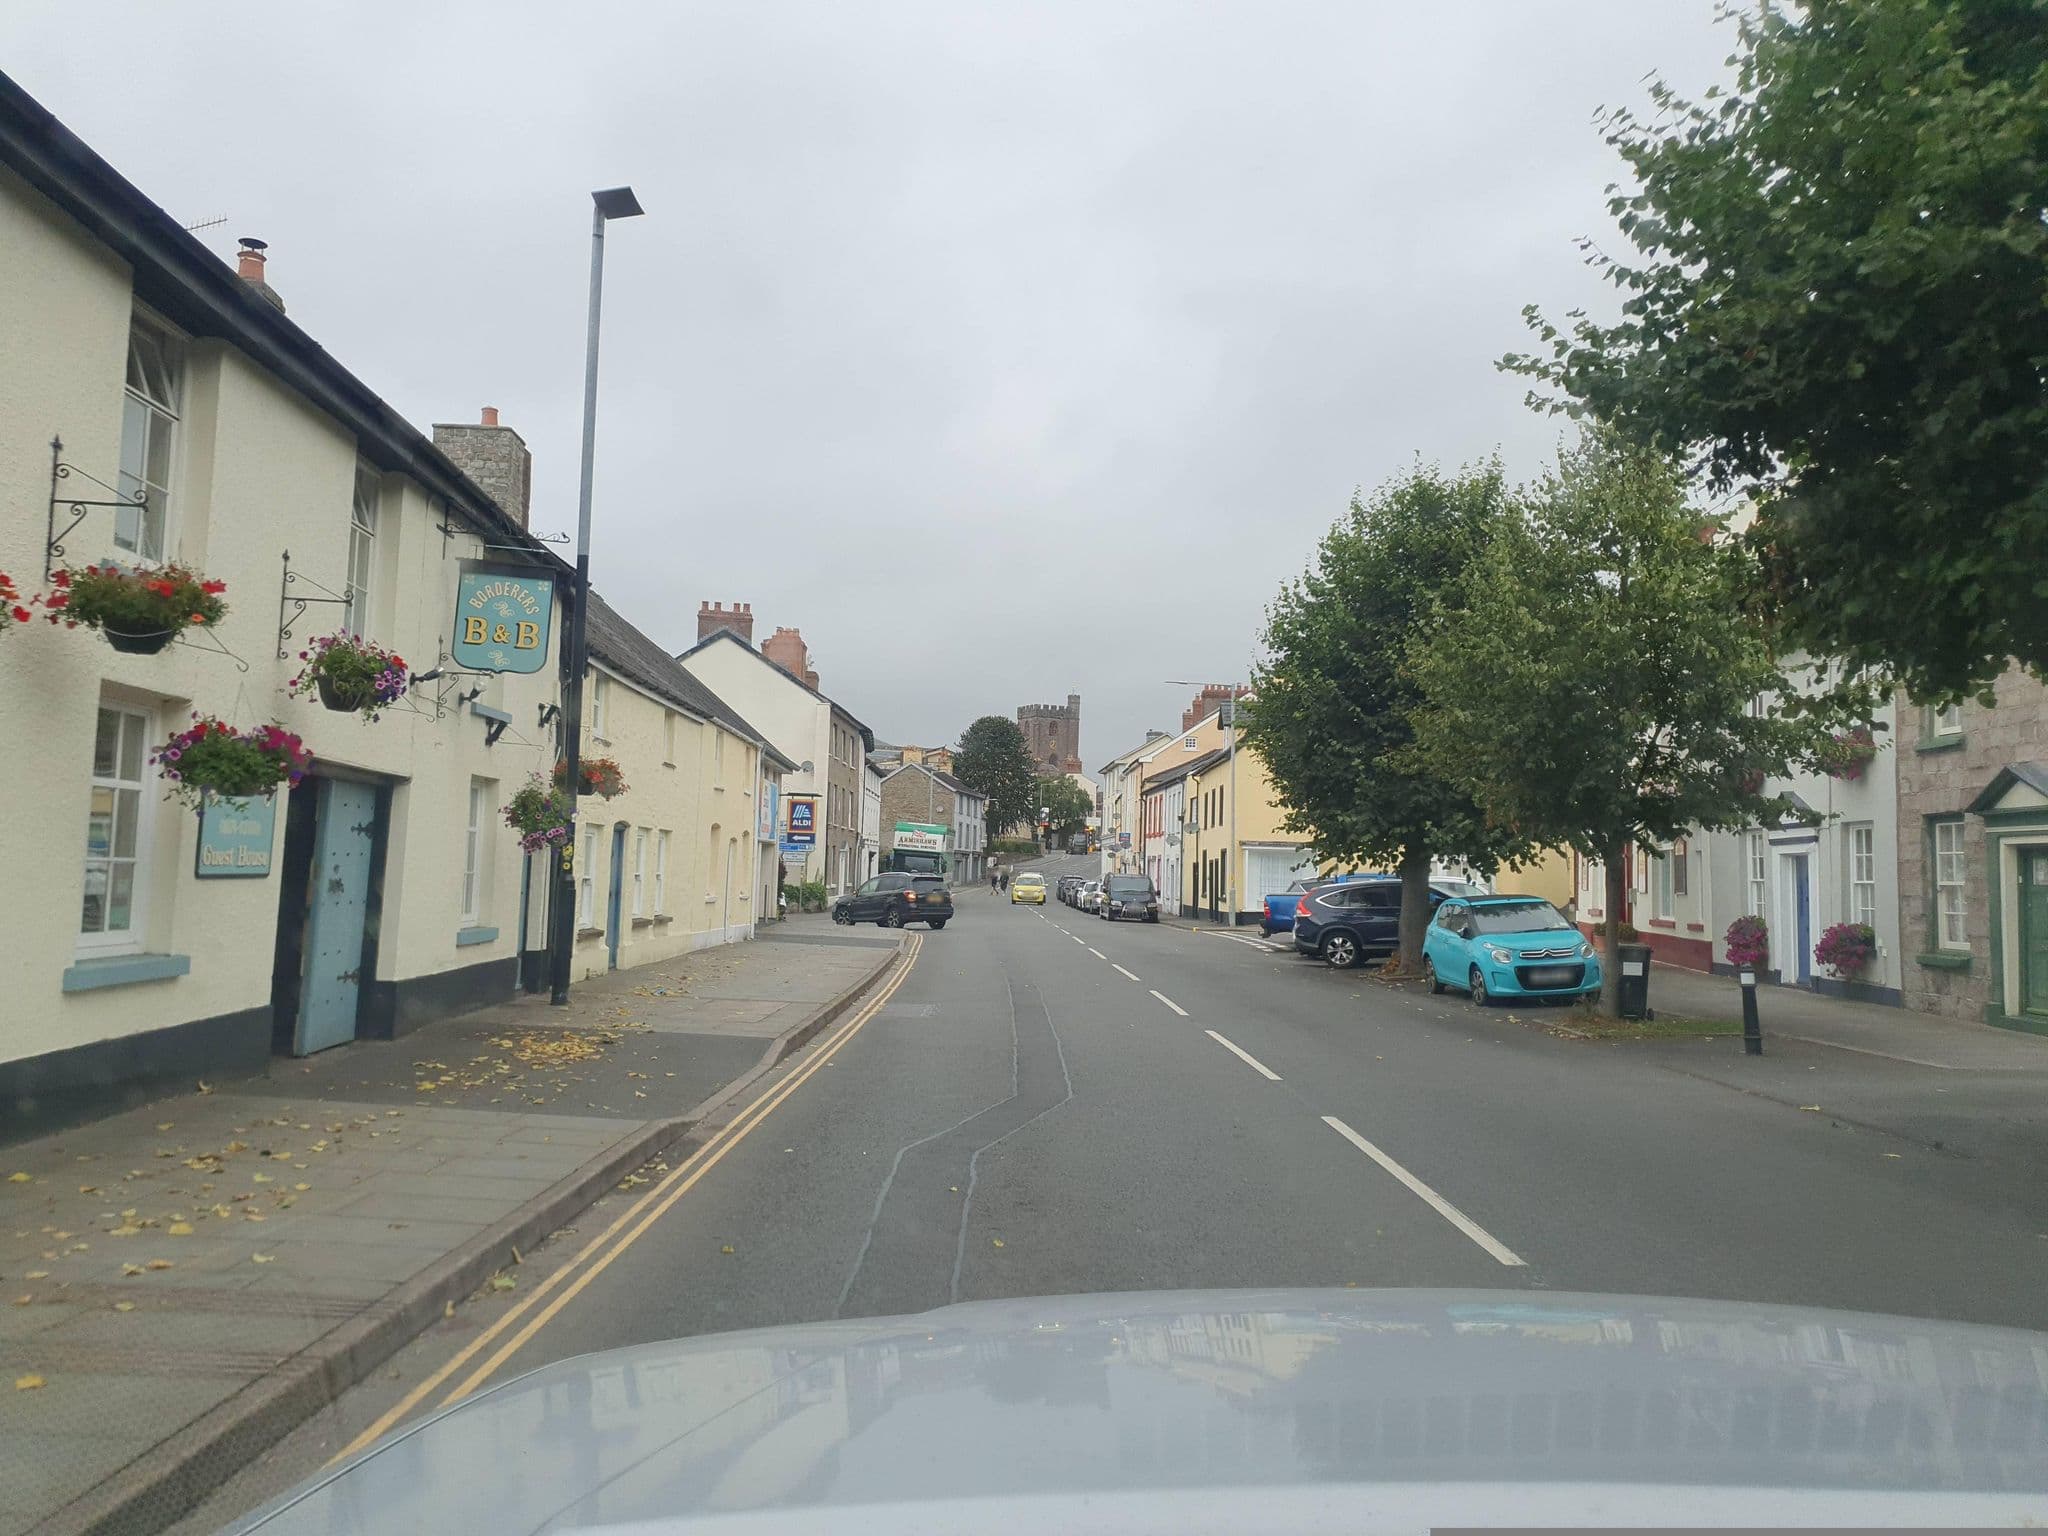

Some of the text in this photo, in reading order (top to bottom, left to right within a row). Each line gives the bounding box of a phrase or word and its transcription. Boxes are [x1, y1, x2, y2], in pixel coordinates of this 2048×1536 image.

[468, 581, 540, 615] BORDERERS
[792, 819, 812, 827] ALDI
[203, 844, 269, 867] Guest House
